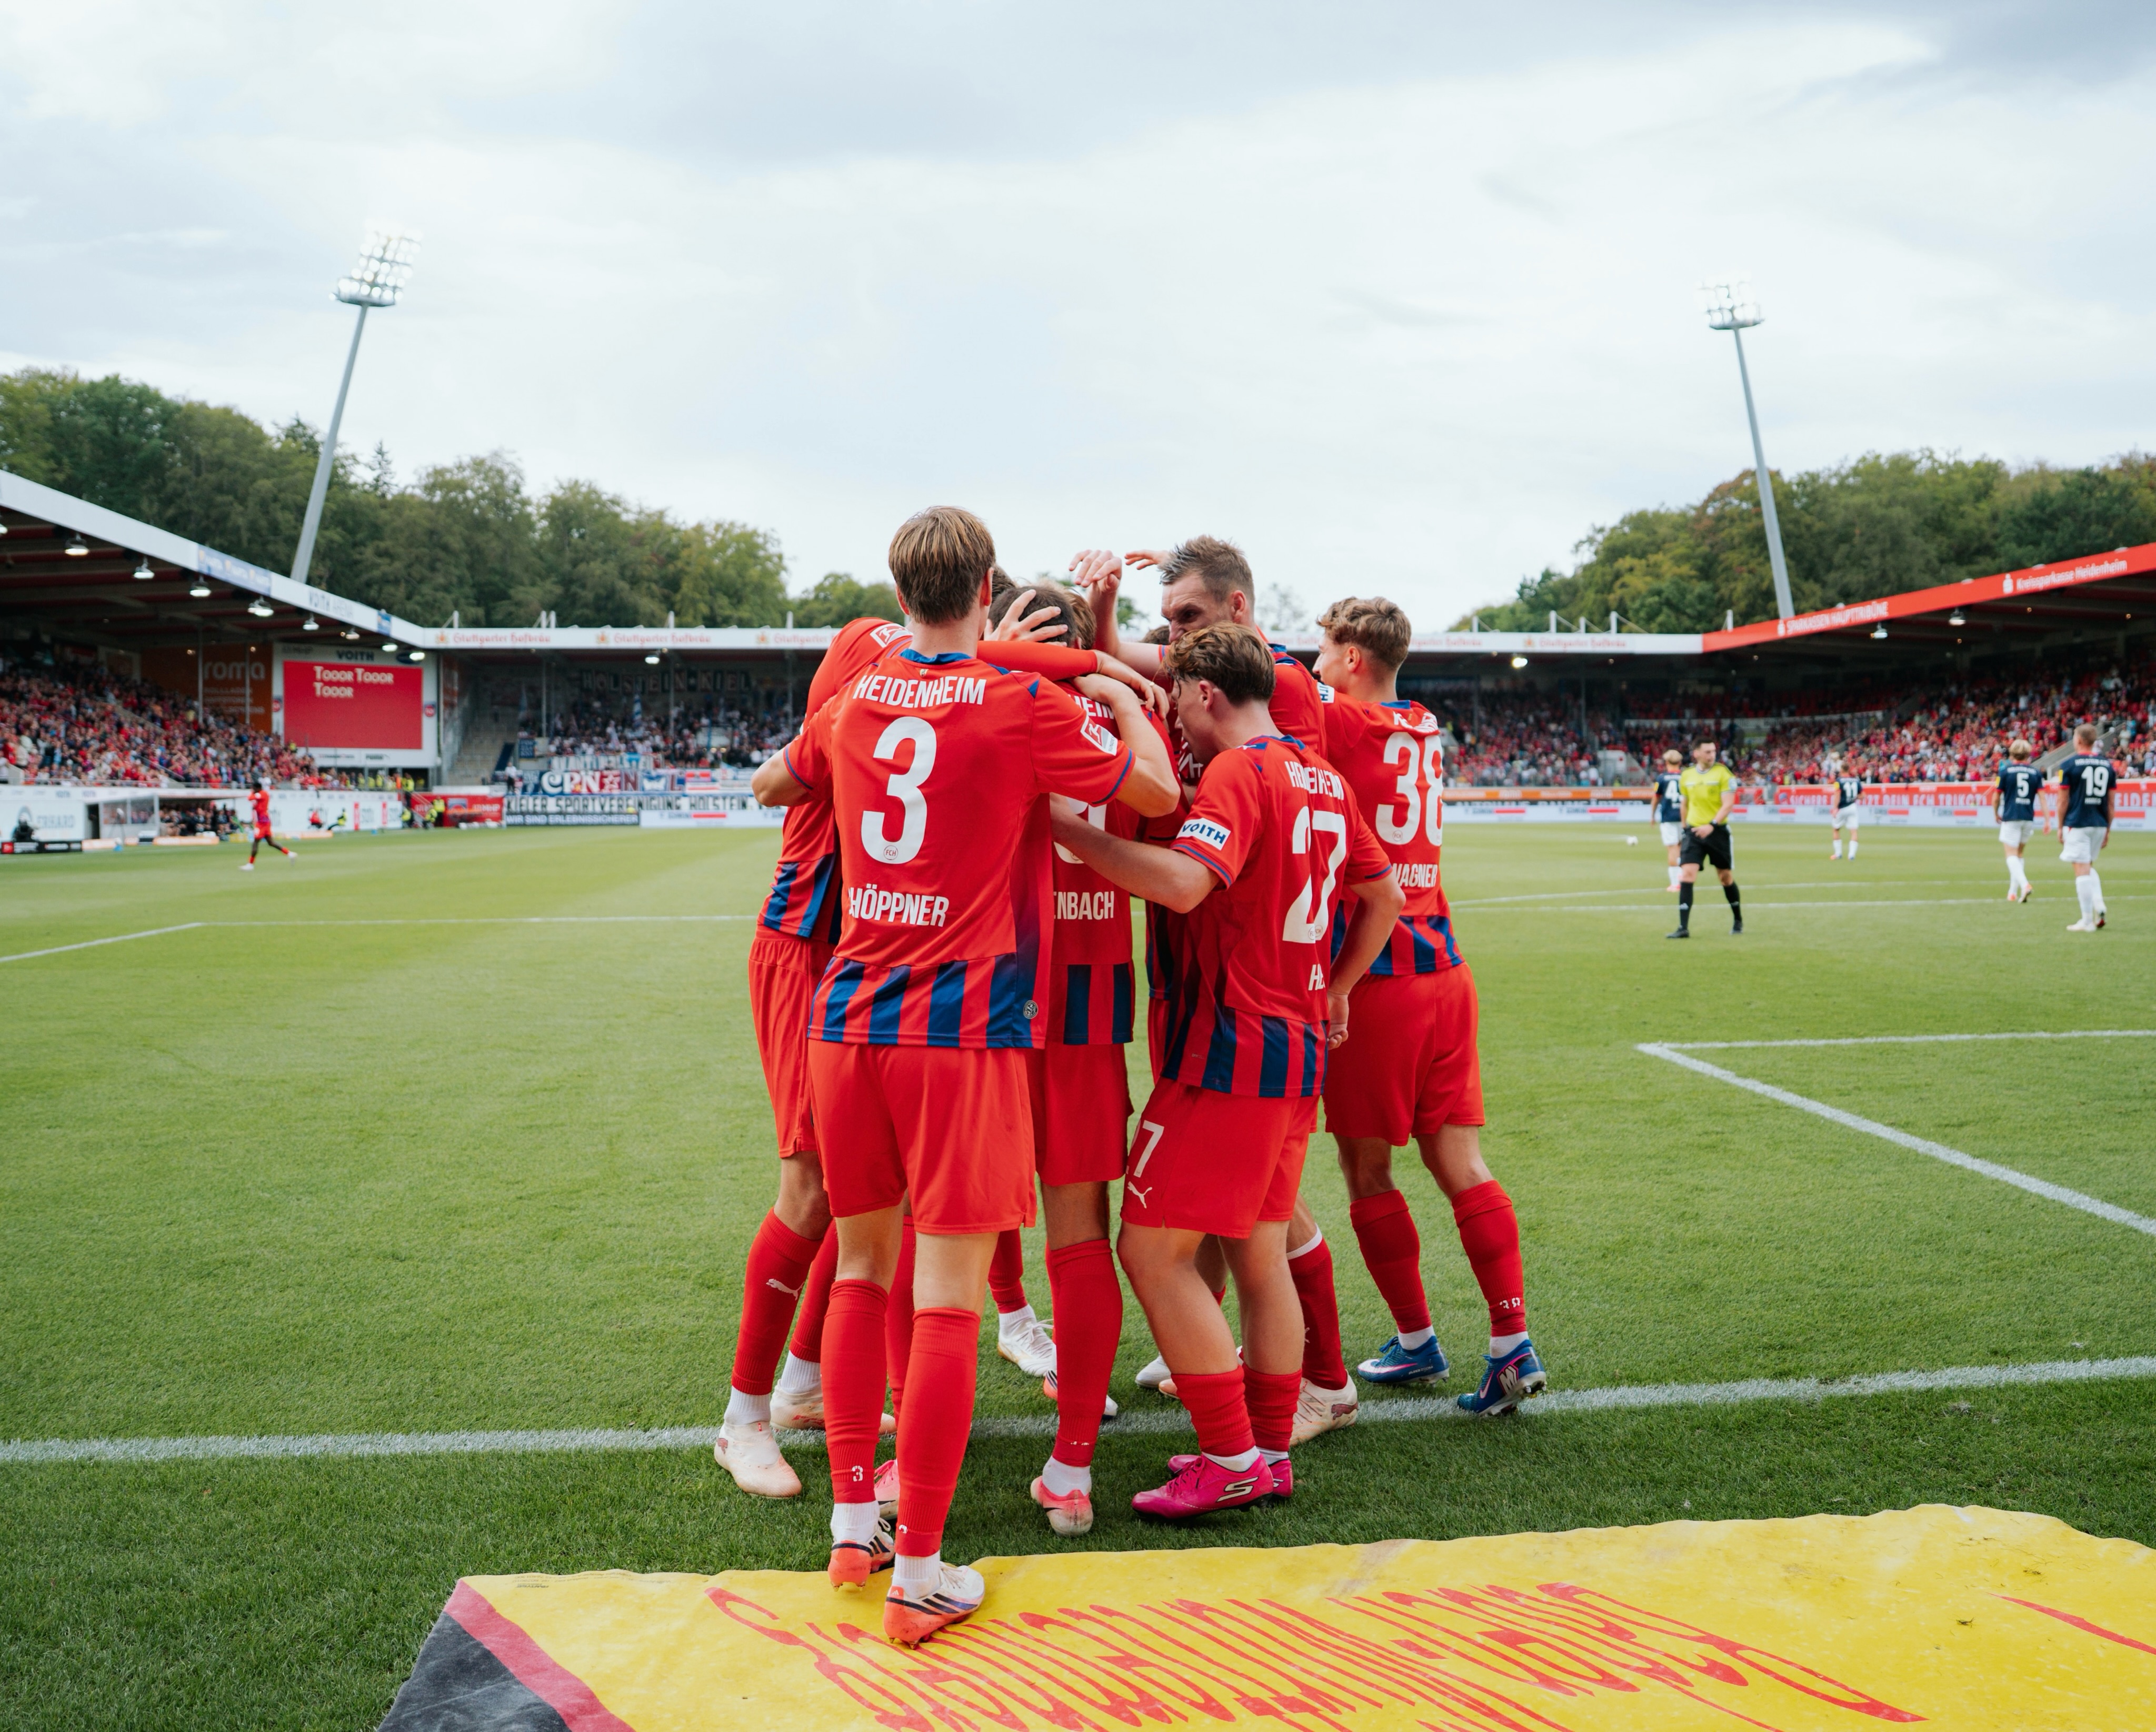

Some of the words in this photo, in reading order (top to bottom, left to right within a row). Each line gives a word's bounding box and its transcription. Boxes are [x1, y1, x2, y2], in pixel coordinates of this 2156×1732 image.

[2075, 559, 2128, 580] Heidenheim
[1786, 613, 1831, 632] SPARKASSEN
[336, 650, 374, 662] VOITH
[203, 661, 265, 681] roma
[853, 674, 986, 709] HEIDENHEIM
[861, 716, 937, 864] 3
[1376, 732, 1443, 846] 38
[1843, 782, 1858, 799] 11
[2017, 772, 2029, 798] 5
[2081, 766, 2109, 797] 19
[507, 796, 552, 812] KIELER
[690, 795, 748, 811] HOLSTEIN
[507, 815, 524, 824] WIR
[526, 815, 546, 824] SIND
[548, 814, 638, 824] ERLEBNISSICHERER
[1182, 823, 1226, 844] VOITH
[1283, 805, 1346, 943] 27
[848, 883, 950, 927] HÖPPNER
[1053, 891, 1115, 920] NBACH
[852, 1465, 863, 1482] 3
